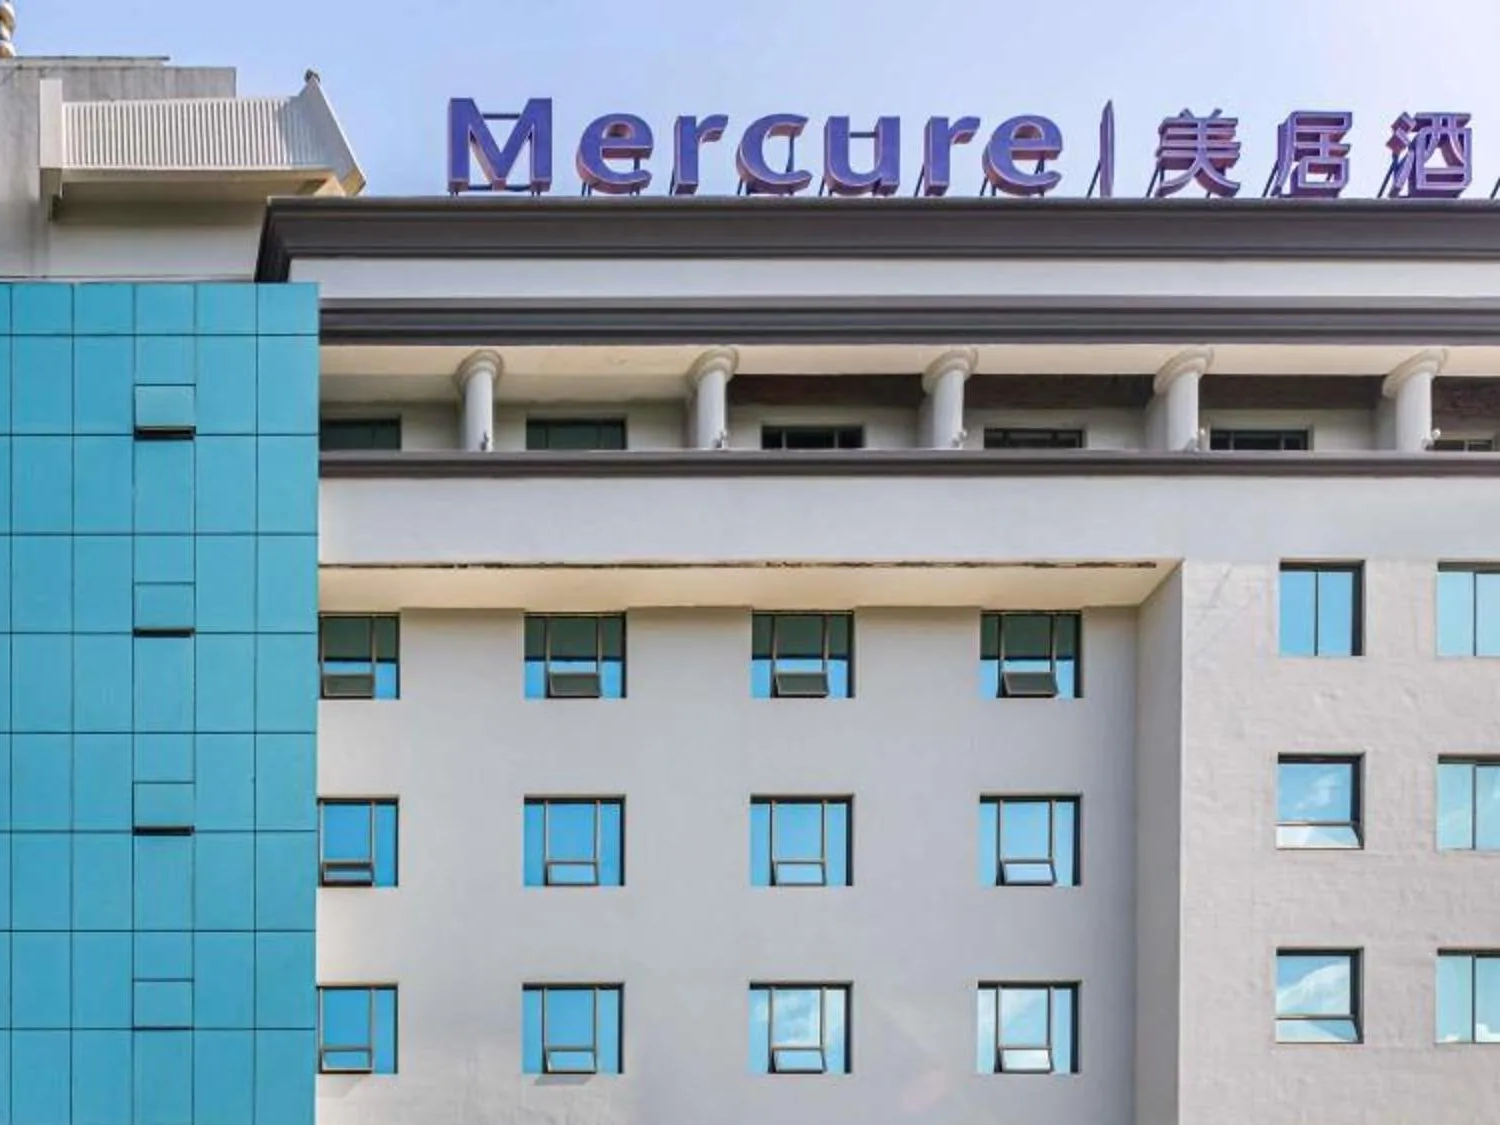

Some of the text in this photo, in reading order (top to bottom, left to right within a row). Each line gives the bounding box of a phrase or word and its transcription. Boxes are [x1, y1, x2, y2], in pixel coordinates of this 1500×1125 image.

[449, 97, 1472, 198] Mercure 美居酒
